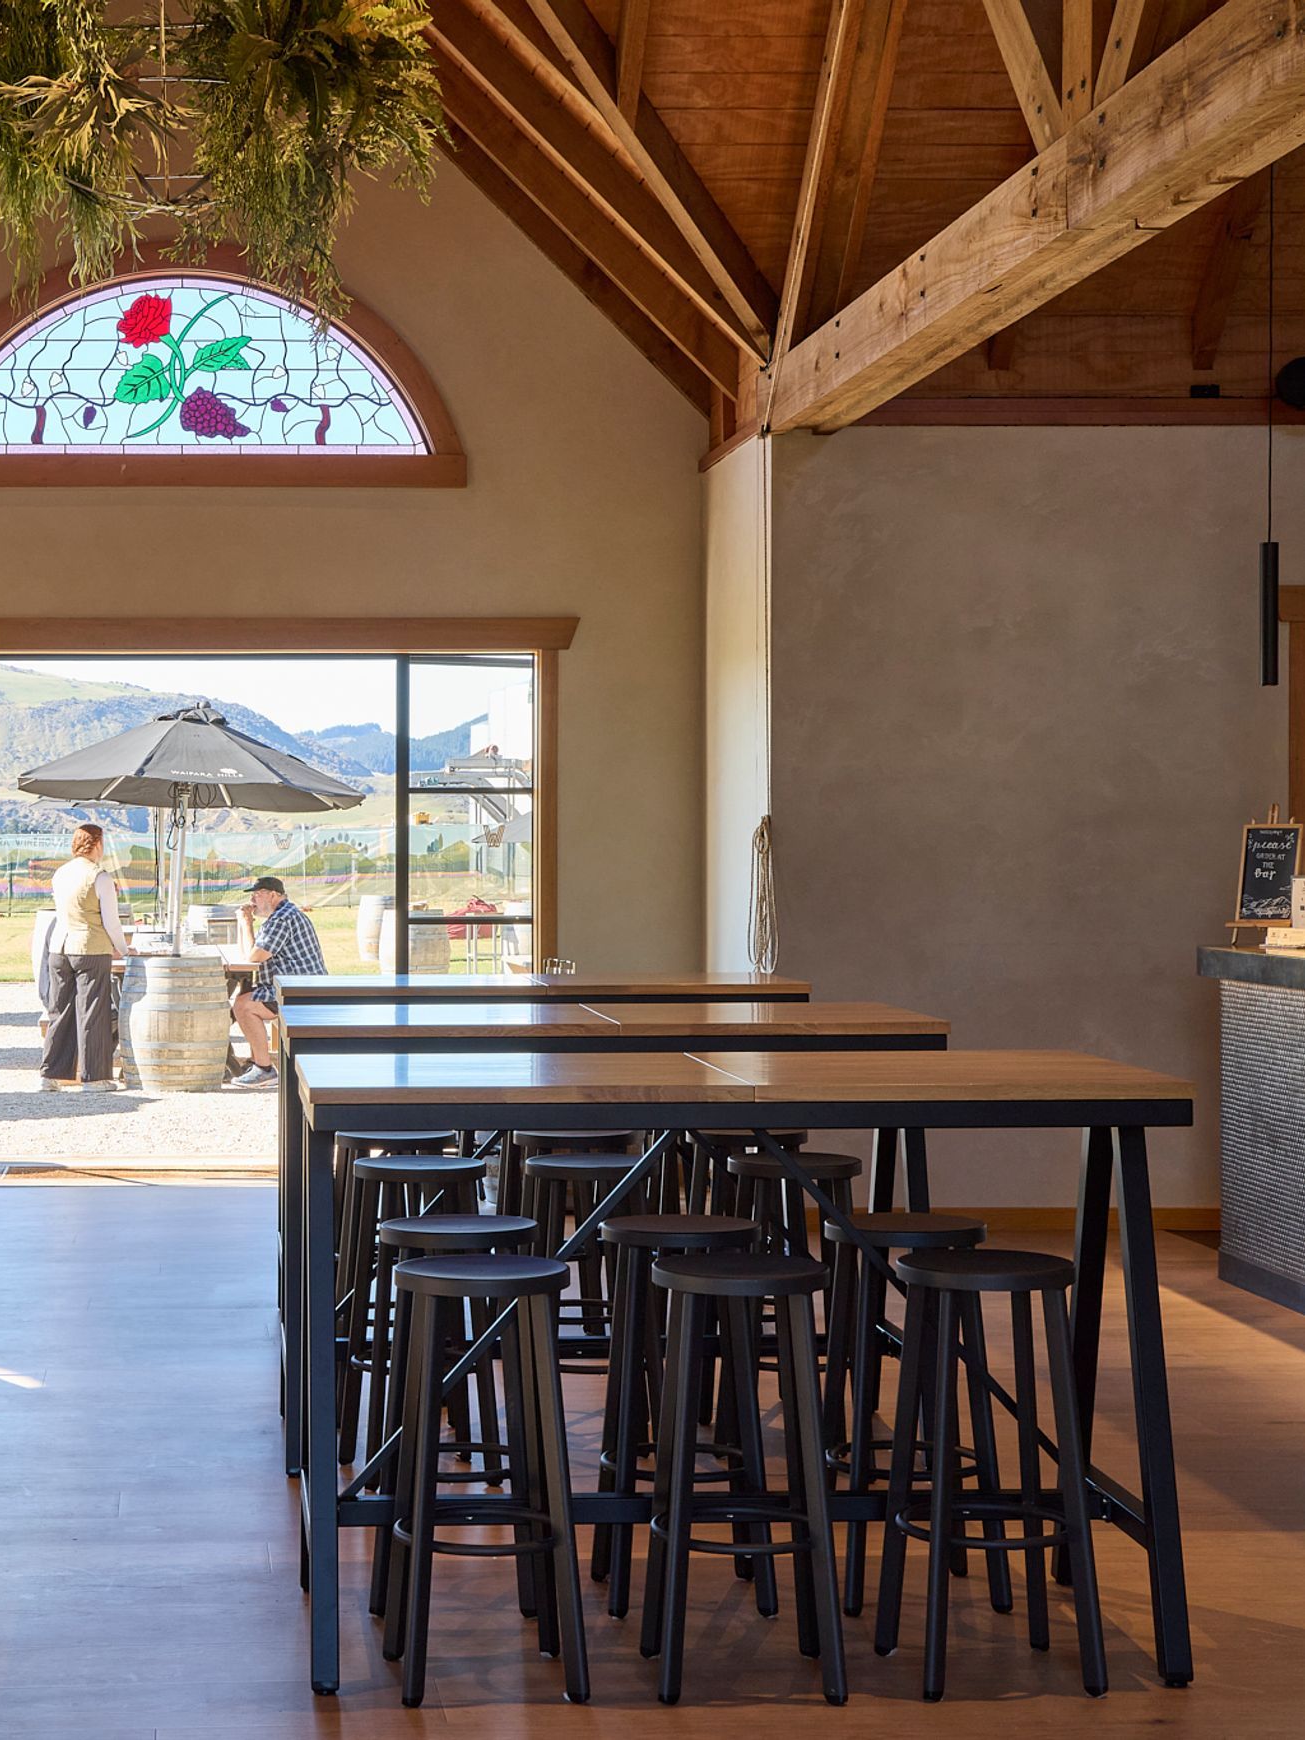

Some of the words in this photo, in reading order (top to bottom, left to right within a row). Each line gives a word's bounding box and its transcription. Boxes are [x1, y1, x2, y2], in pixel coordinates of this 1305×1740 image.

[170, 769, 213, 777] WAIPARA
[1252, 841, 1292, 852] please
[1262, 861, 1275, 869] THE
